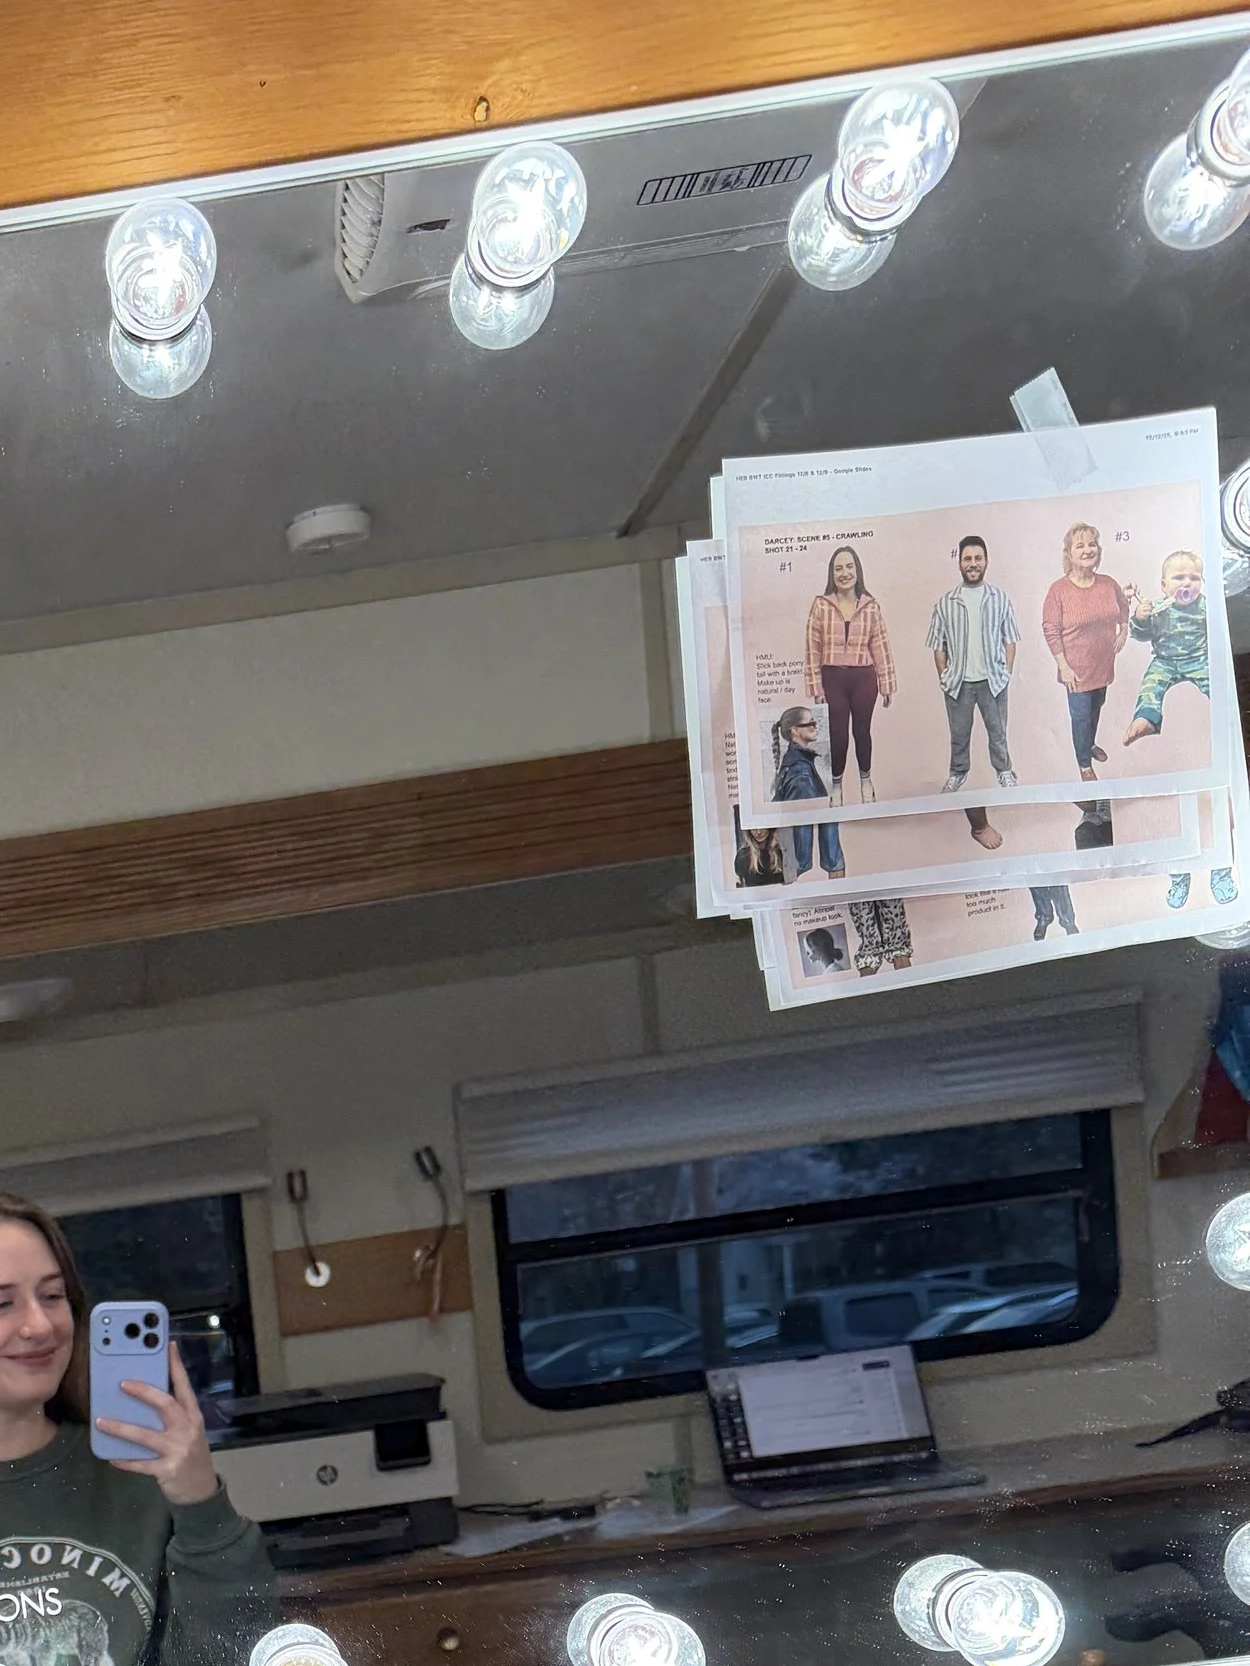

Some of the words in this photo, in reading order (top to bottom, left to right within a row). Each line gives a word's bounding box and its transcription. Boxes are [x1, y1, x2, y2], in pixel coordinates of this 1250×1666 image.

[764, 537, 795, 546] DARCEY:
[797, 535, 821, 543] SCENE
[836, 530, 874, 540] CRAWLING
[1114, 531, 1130, 542] #3
[764, 546, 784, 554] SHOT
[779, 562, 792, 572] #1
